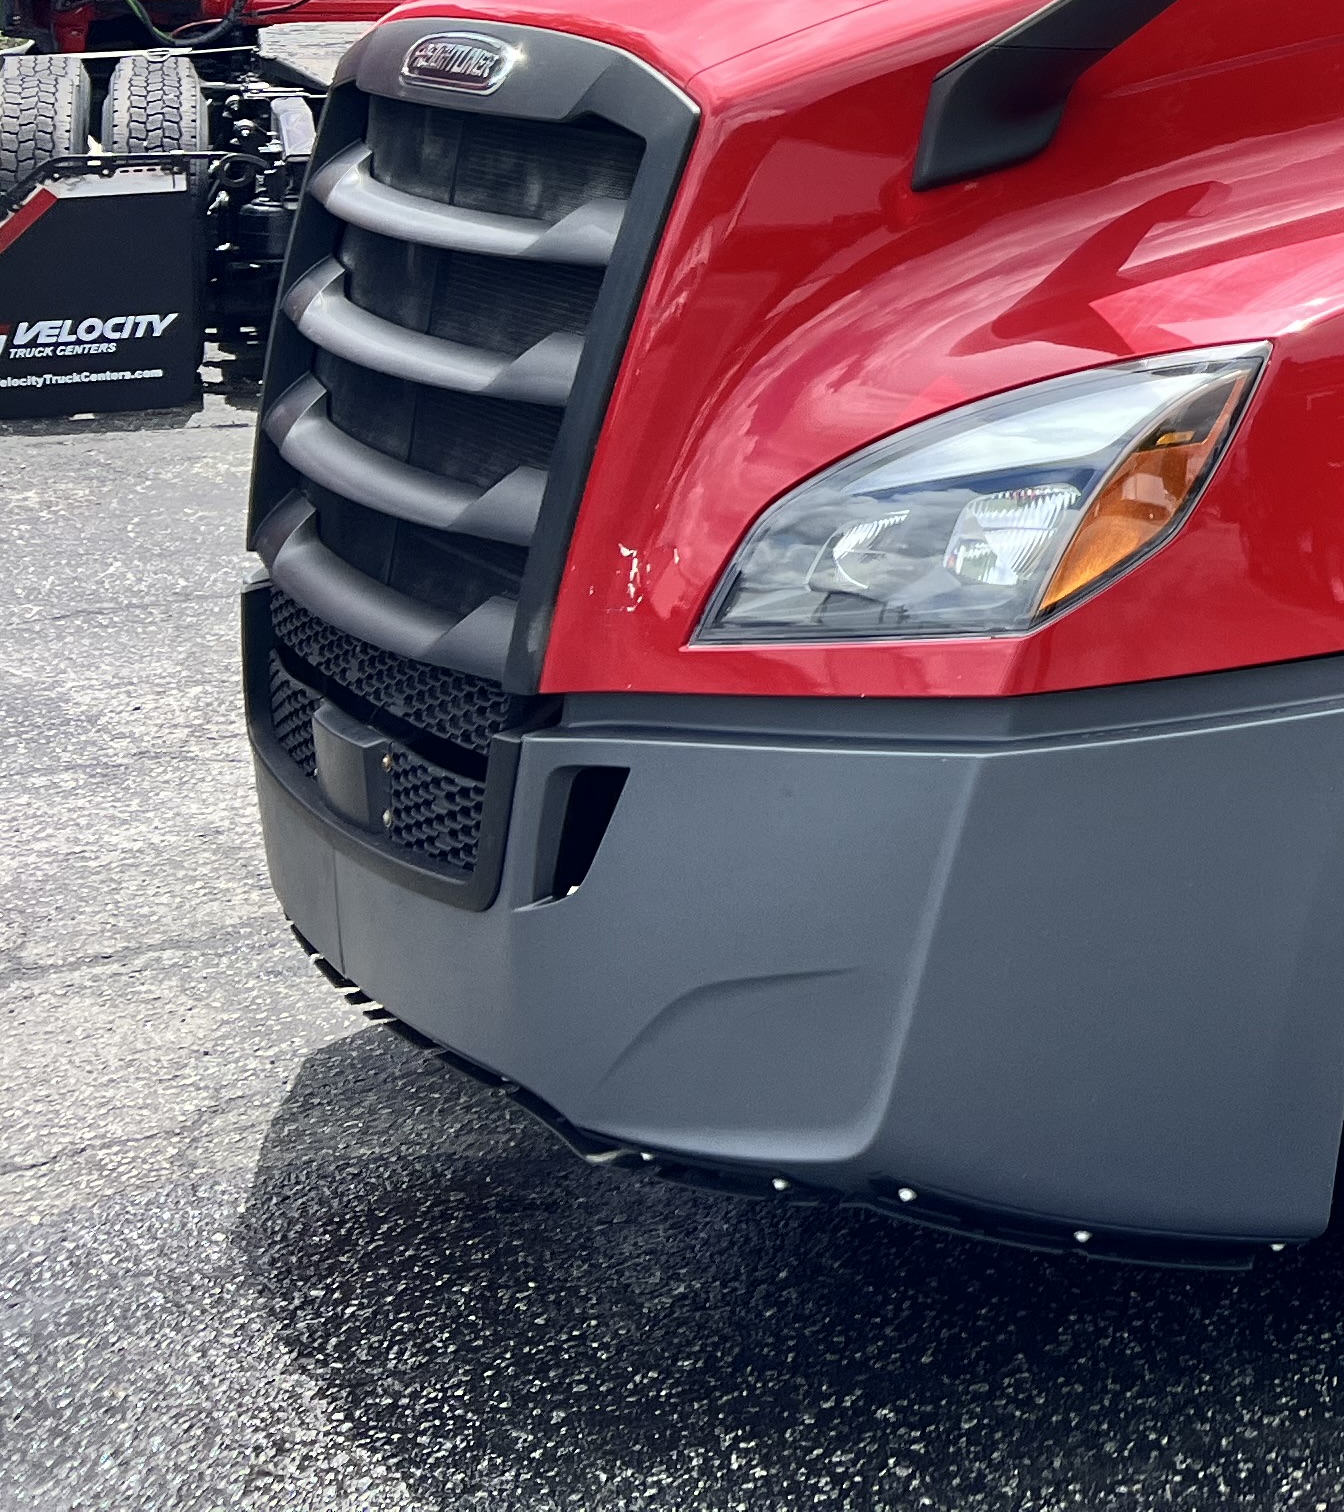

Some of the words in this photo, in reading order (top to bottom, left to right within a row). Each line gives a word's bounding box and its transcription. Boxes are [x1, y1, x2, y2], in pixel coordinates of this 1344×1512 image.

[13, 313, 179, 345] VELOCITY
[9, 346, 53, 359] TRUCK
[56, 342, 117, 357] CENTERS
[0, 368, 163, 388] elocityTruckCenters.com
